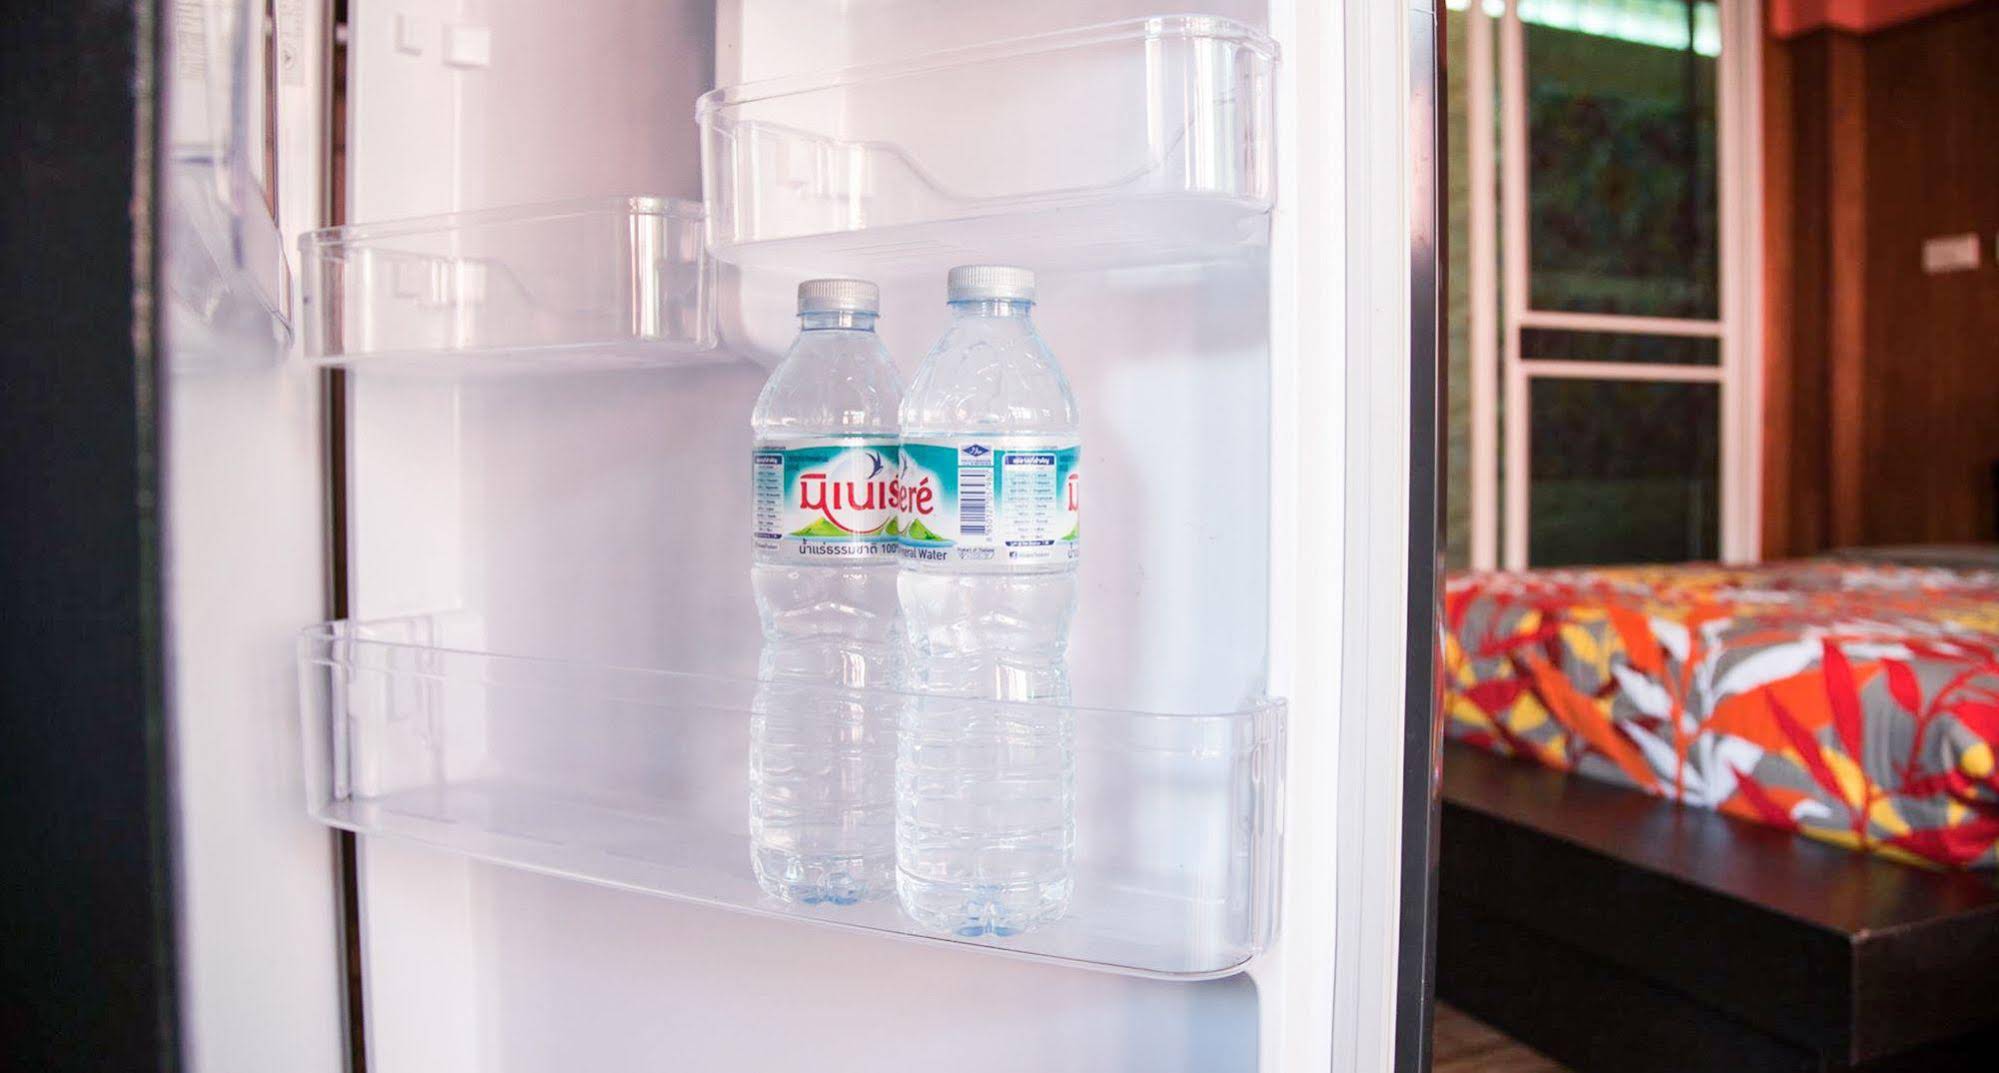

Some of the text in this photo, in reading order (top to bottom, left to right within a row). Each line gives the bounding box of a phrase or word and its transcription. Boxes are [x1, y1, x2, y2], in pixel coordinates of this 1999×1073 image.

[799, 538, 878, 555] น้ำแร่ธรรมชาติ
[918, 549, 948, 560] Water
